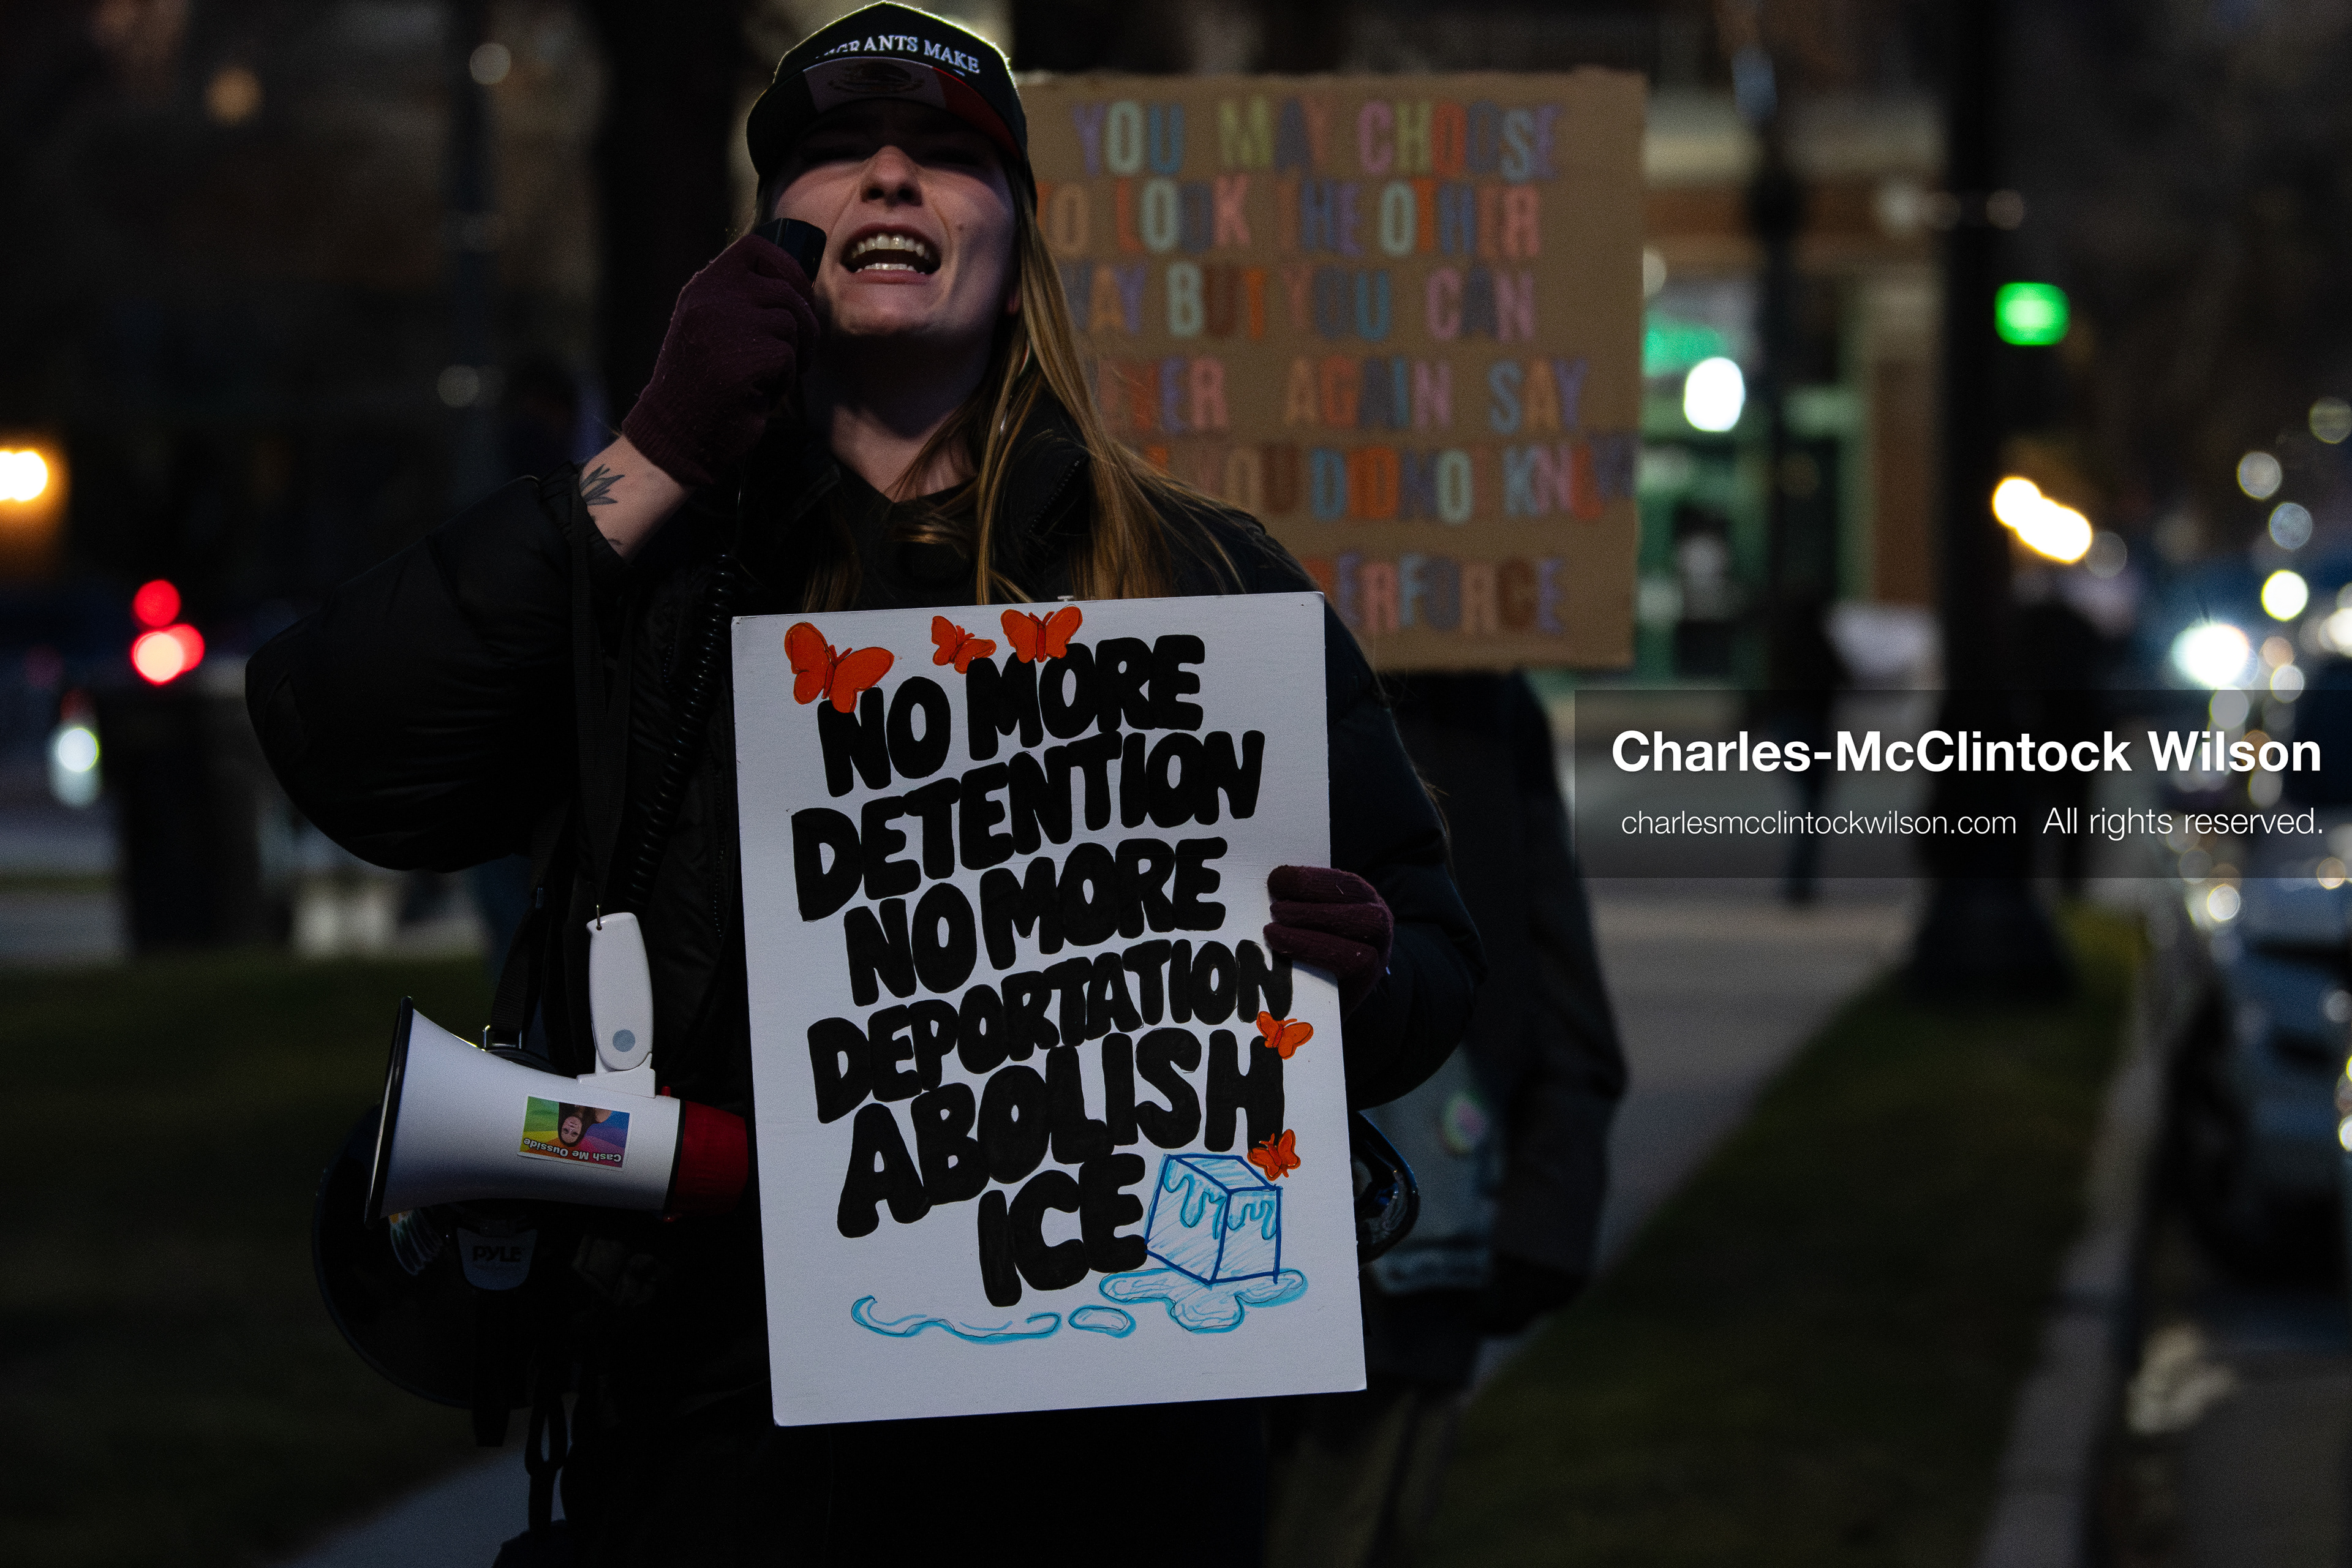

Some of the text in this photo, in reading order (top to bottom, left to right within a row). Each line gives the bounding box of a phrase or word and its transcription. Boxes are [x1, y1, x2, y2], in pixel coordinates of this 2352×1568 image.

[923, 39, 981, 74] MAKE
[1071, 92, 1561, 183] YOU MAY CHOOSE
[1115, 173, 1251, 255] LOOK
[1275, 178, 1363, 257] THE
[1379, 176, 1542, 258] OTHER
[1167, 261, 1268, 341] BUT
[1281, 261, 1392, 342] YOU
[1425, 266, 1535, 342] CAN
[1085, 353, 1589, 435] EVER AGAIN SAY
[817, 634, 1205, 797] NO MORE
[791, 729, 1265, 922] DETENTION
[844, 836, 1227, 1006] NO MORE
[807, 938, 1293, 1124] DEPORTATION
[523, 1137, 622, 1163] Cash Me Ousside
[837, 1027, 1285, 1238] ABOLISH
[473, 1245, 522, 1262] PYLE
[978, 1153, 1147, 1307] ICE
